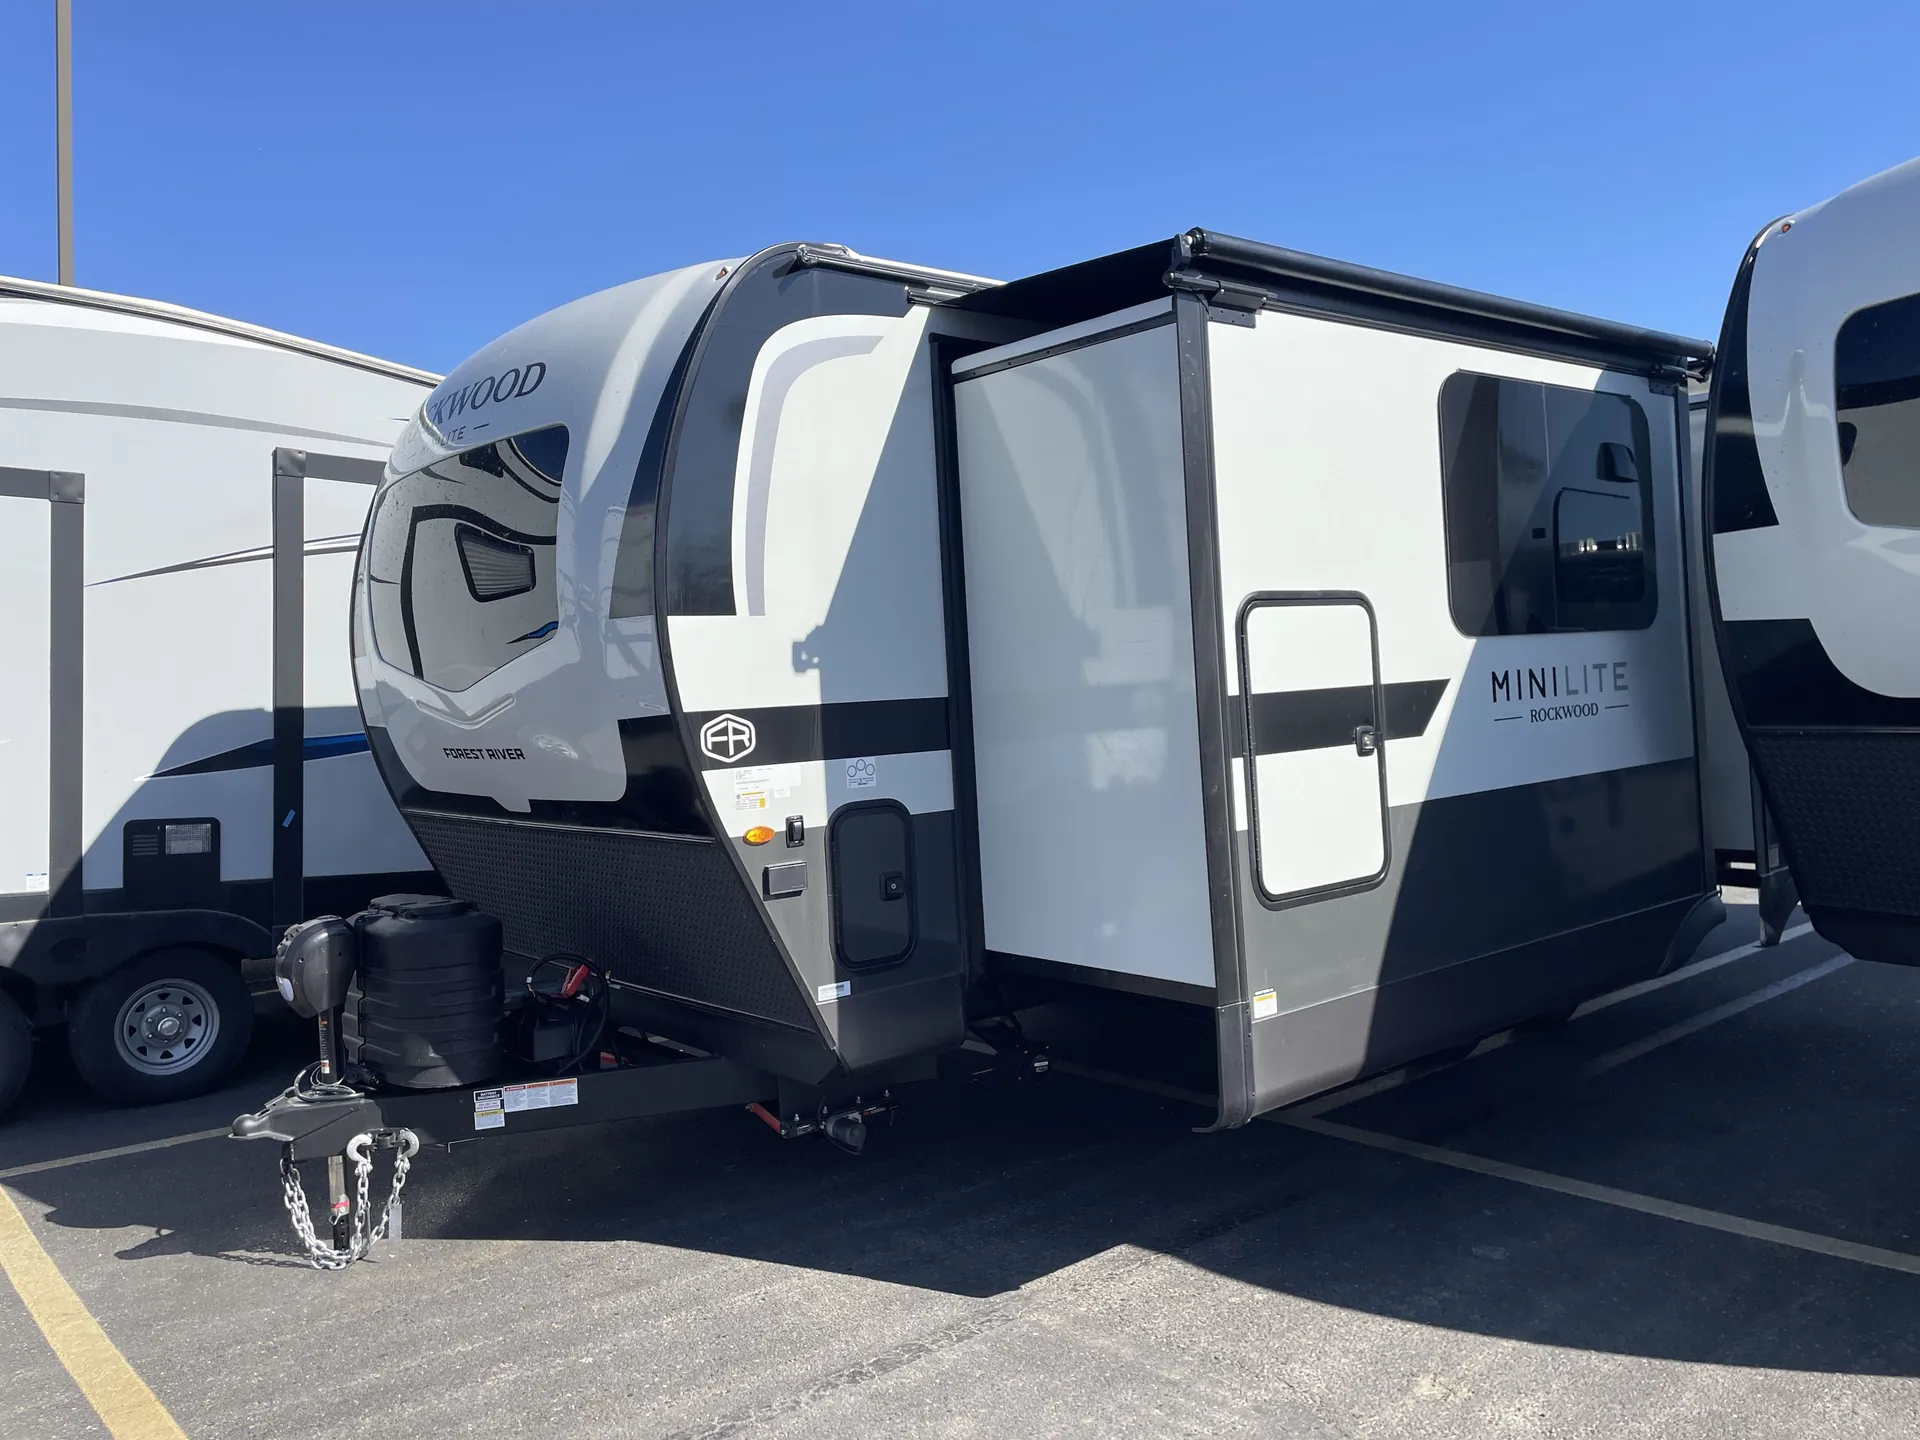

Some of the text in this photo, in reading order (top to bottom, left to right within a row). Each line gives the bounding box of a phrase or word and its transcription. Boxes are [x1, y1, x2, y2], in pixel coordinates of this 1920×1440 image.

[1530, 703, 1599, 723] ROCKWOOD
[443, 747, 526, 760] FOREST RIVER
